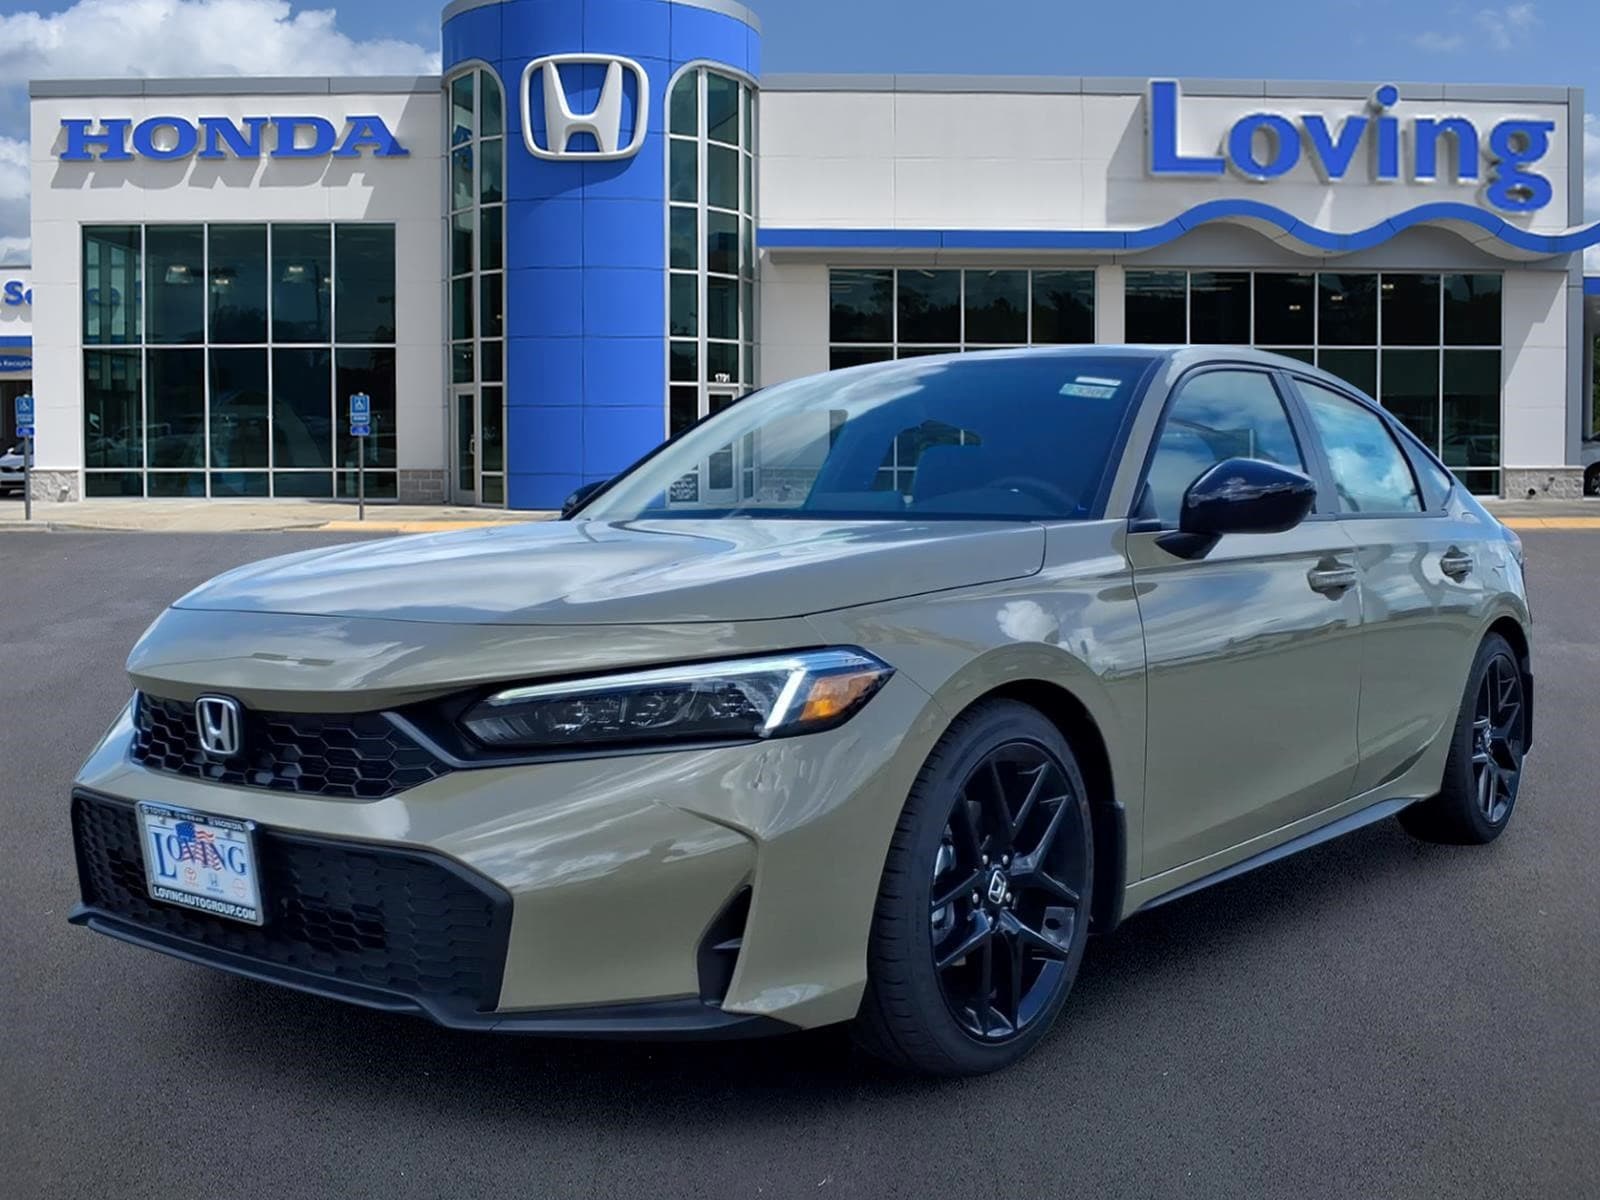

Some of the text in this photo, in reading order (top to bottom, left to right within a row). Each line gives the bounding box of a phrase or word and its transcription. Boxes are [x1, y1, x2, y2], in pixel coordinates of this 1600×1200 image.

[60, 115, 410, 161] HONDA
[1148, 79, 1555, 212] Loving
[152, 832, 247, 878] LOVING
[153, 886, 256, 919] LOVINGAUTOGROUP.COM
